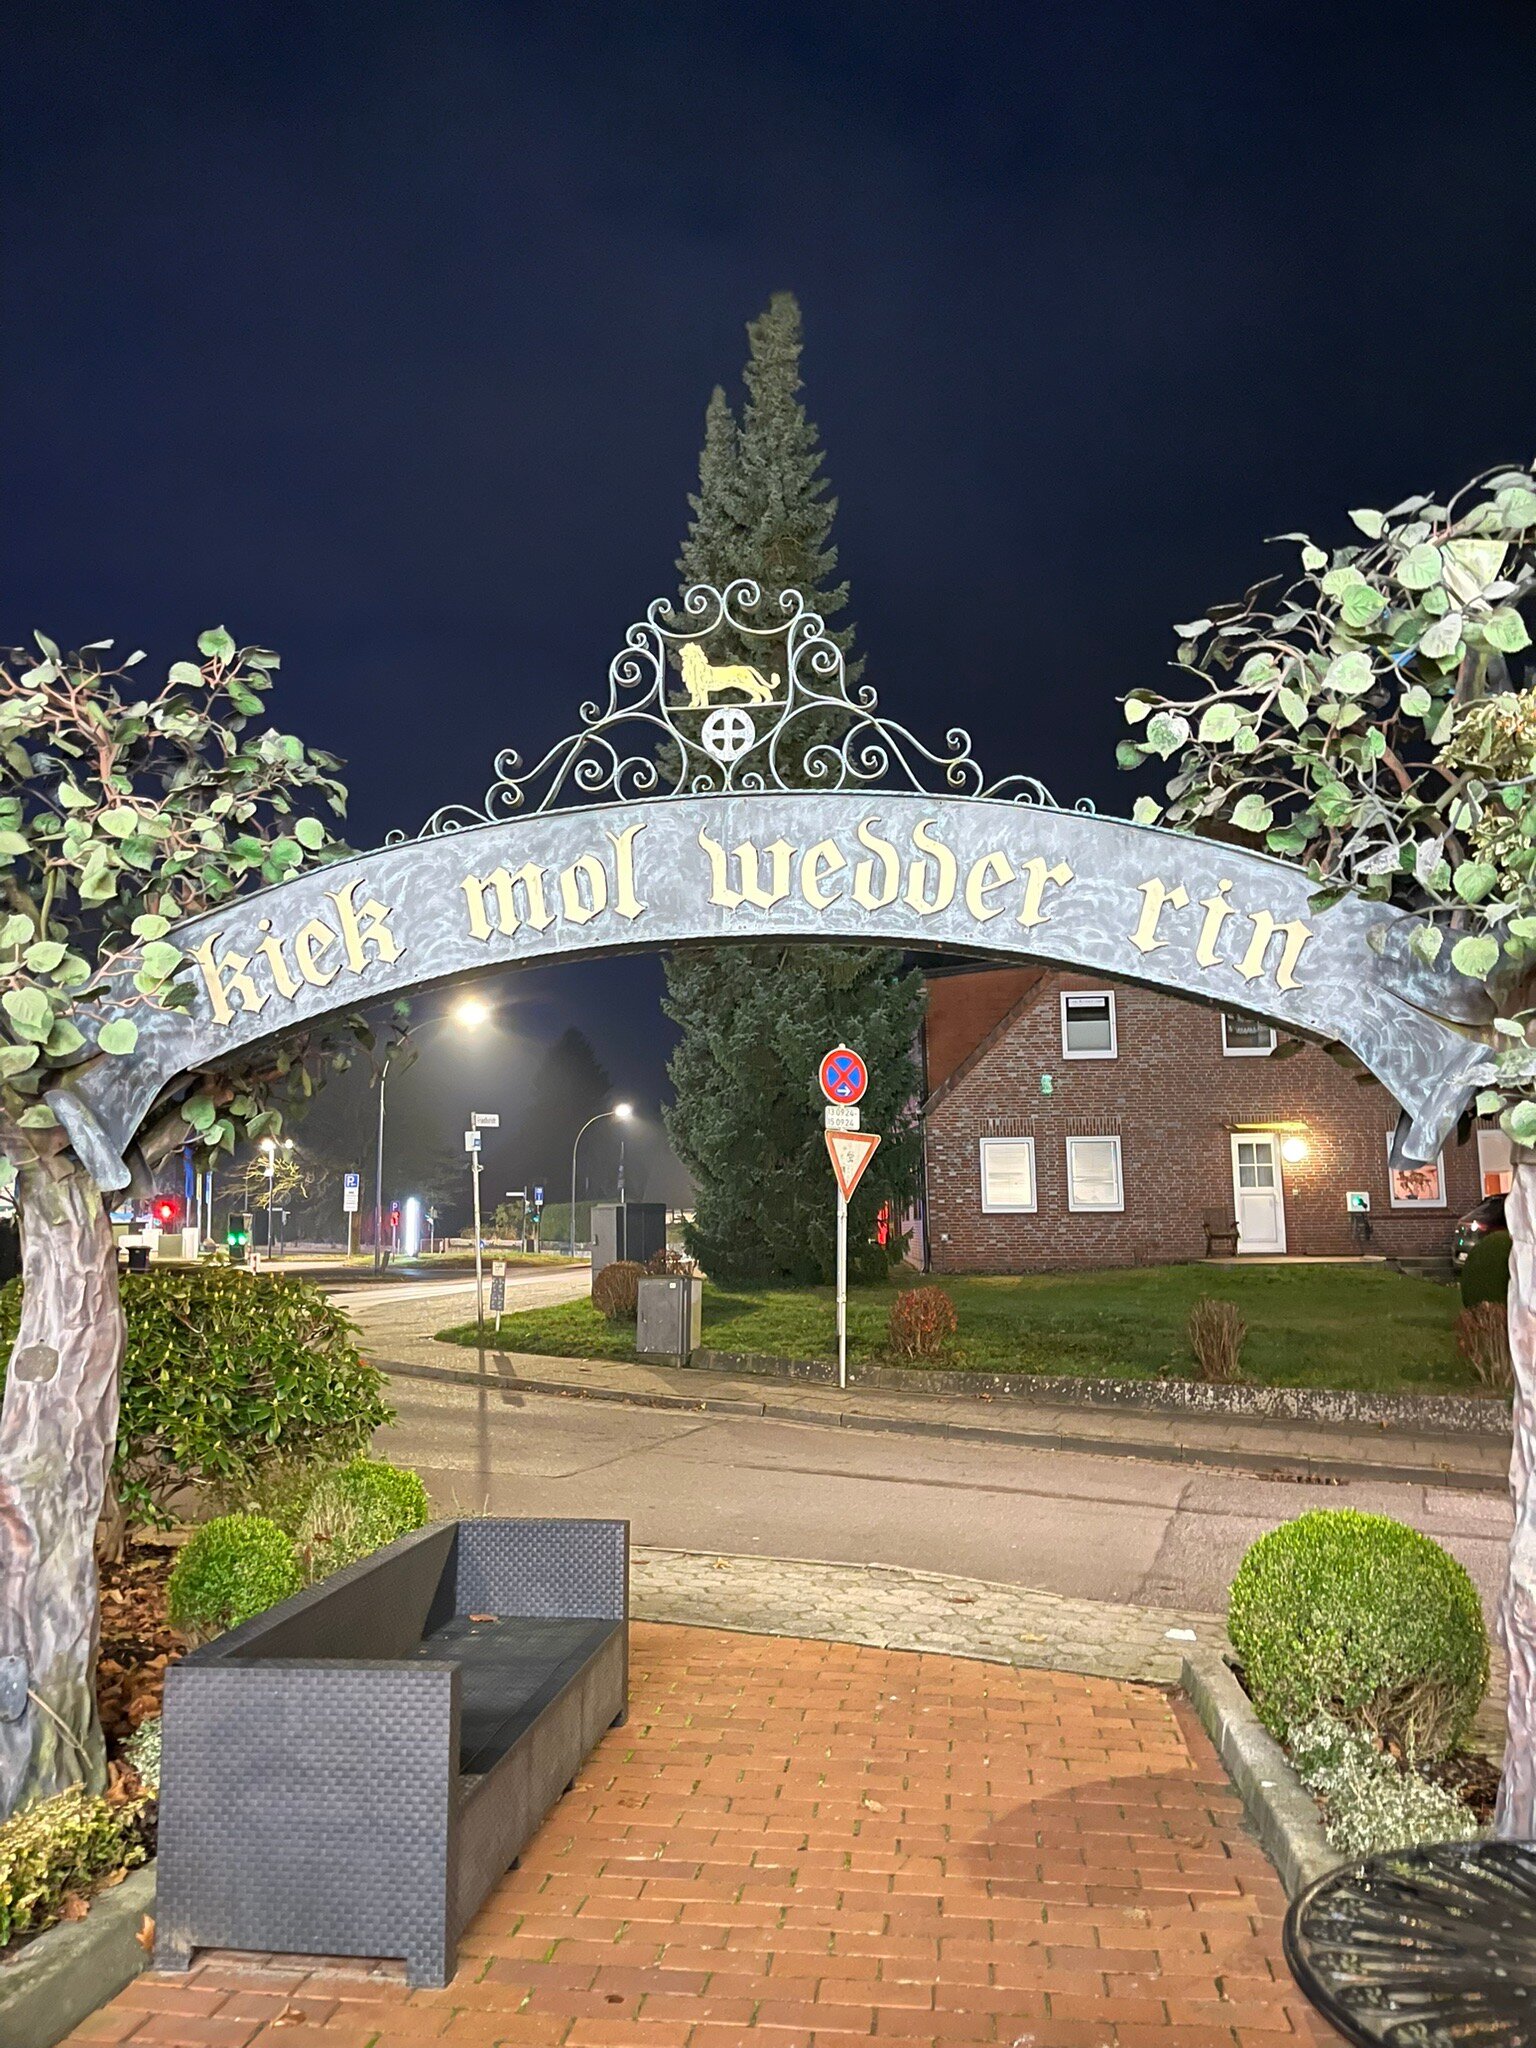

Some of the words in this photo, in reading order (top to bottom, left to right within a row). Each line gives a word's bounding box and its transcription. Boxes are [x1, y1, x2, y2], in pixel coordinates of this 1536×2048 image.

[186, 878, 407, 1026] kiek
[459, 823, 648, 942] mol
[698, 816, 1074, 928] wedder
[1127, 876, 1314, 995] rin
